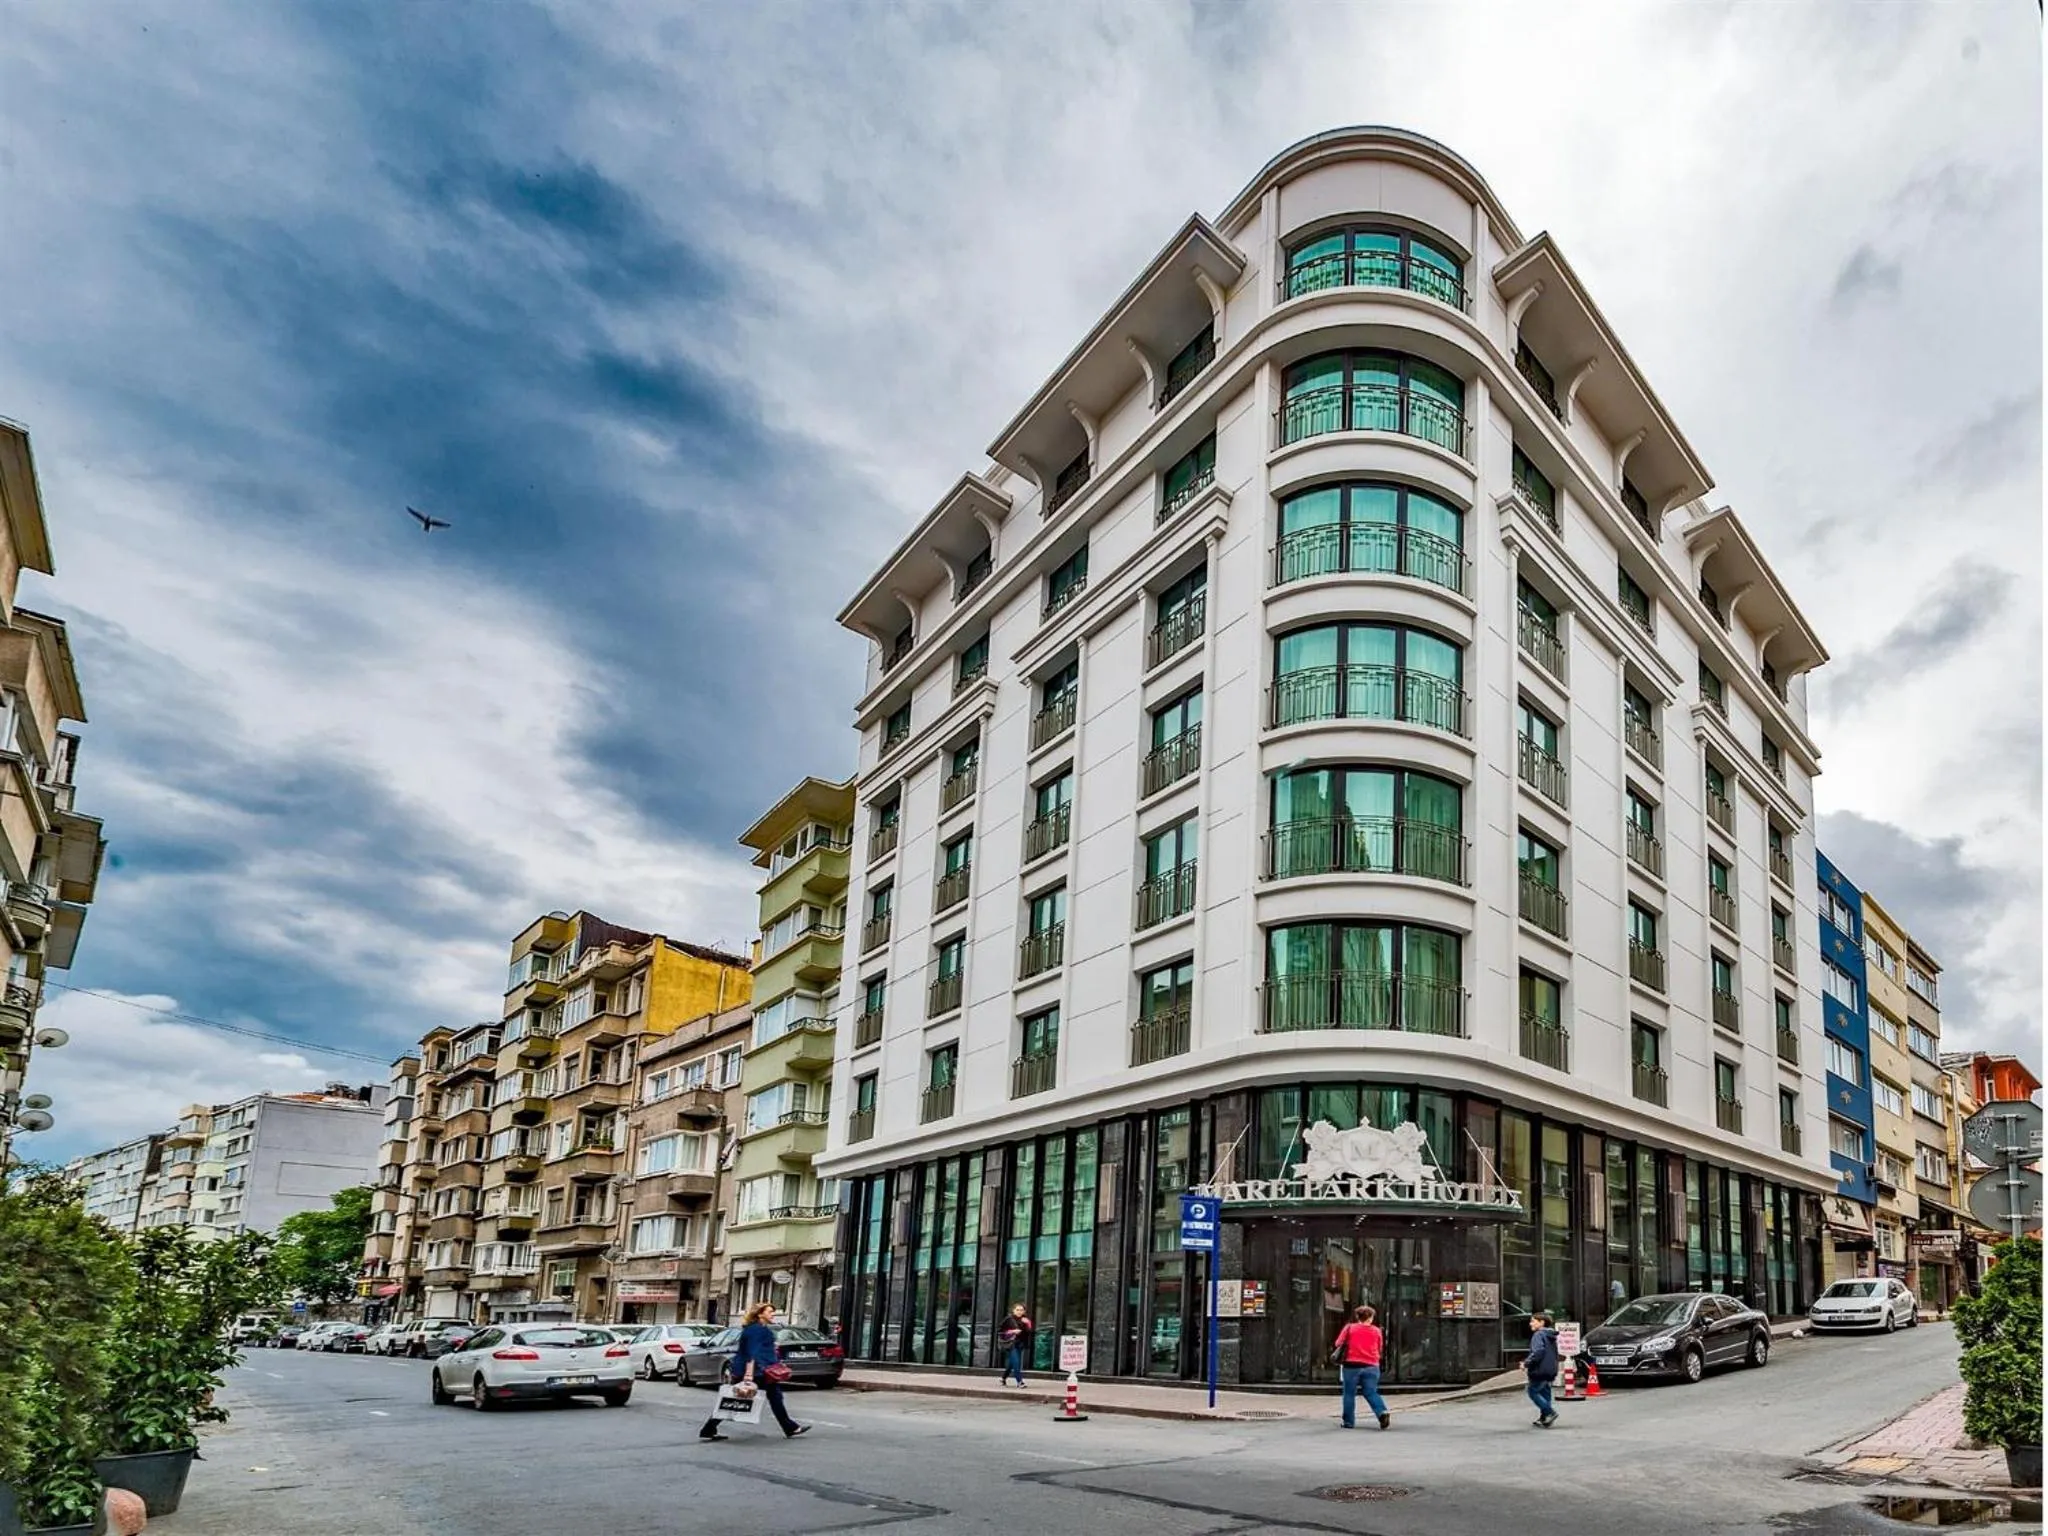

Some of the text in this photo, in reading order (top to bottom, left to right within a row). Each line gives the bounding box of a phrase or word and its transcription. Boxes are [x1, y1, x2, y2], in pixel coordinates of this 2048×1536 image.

[1194, 1177, 1523, 1209] MARE PARK HOTEL
